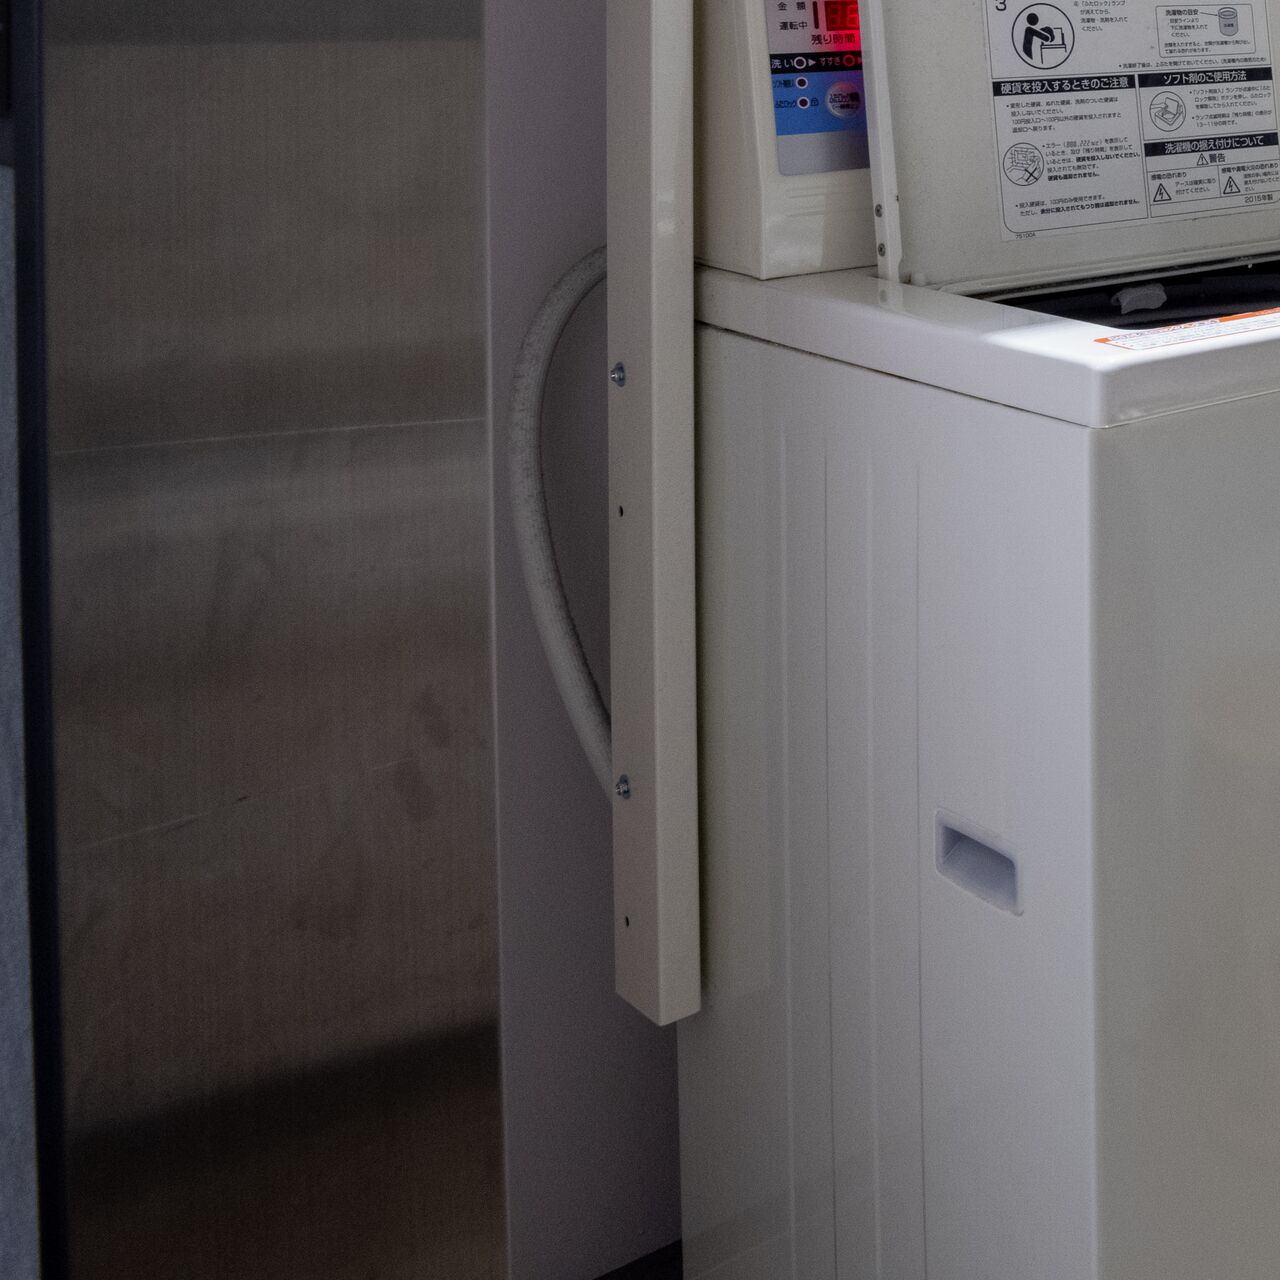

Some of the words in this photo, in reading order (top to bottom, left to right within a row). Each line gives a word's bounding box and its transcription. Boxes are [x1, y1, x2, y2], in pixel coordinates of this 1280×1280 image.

[780, 22, 808, 30] 運転中
[771, 59, 793, 68] 洗い
[1164, 71, 1247, 84] ソフト剤のご使用方法
[1001, 77, 1128, 94] 硬貨を投入するときのご注意
[1165, 136, 1264, 153] 洗濯機の据え付けについて
[1209, 153, 1225, 163] 警告
[1245, 195, 1273, 203] 2015年製
